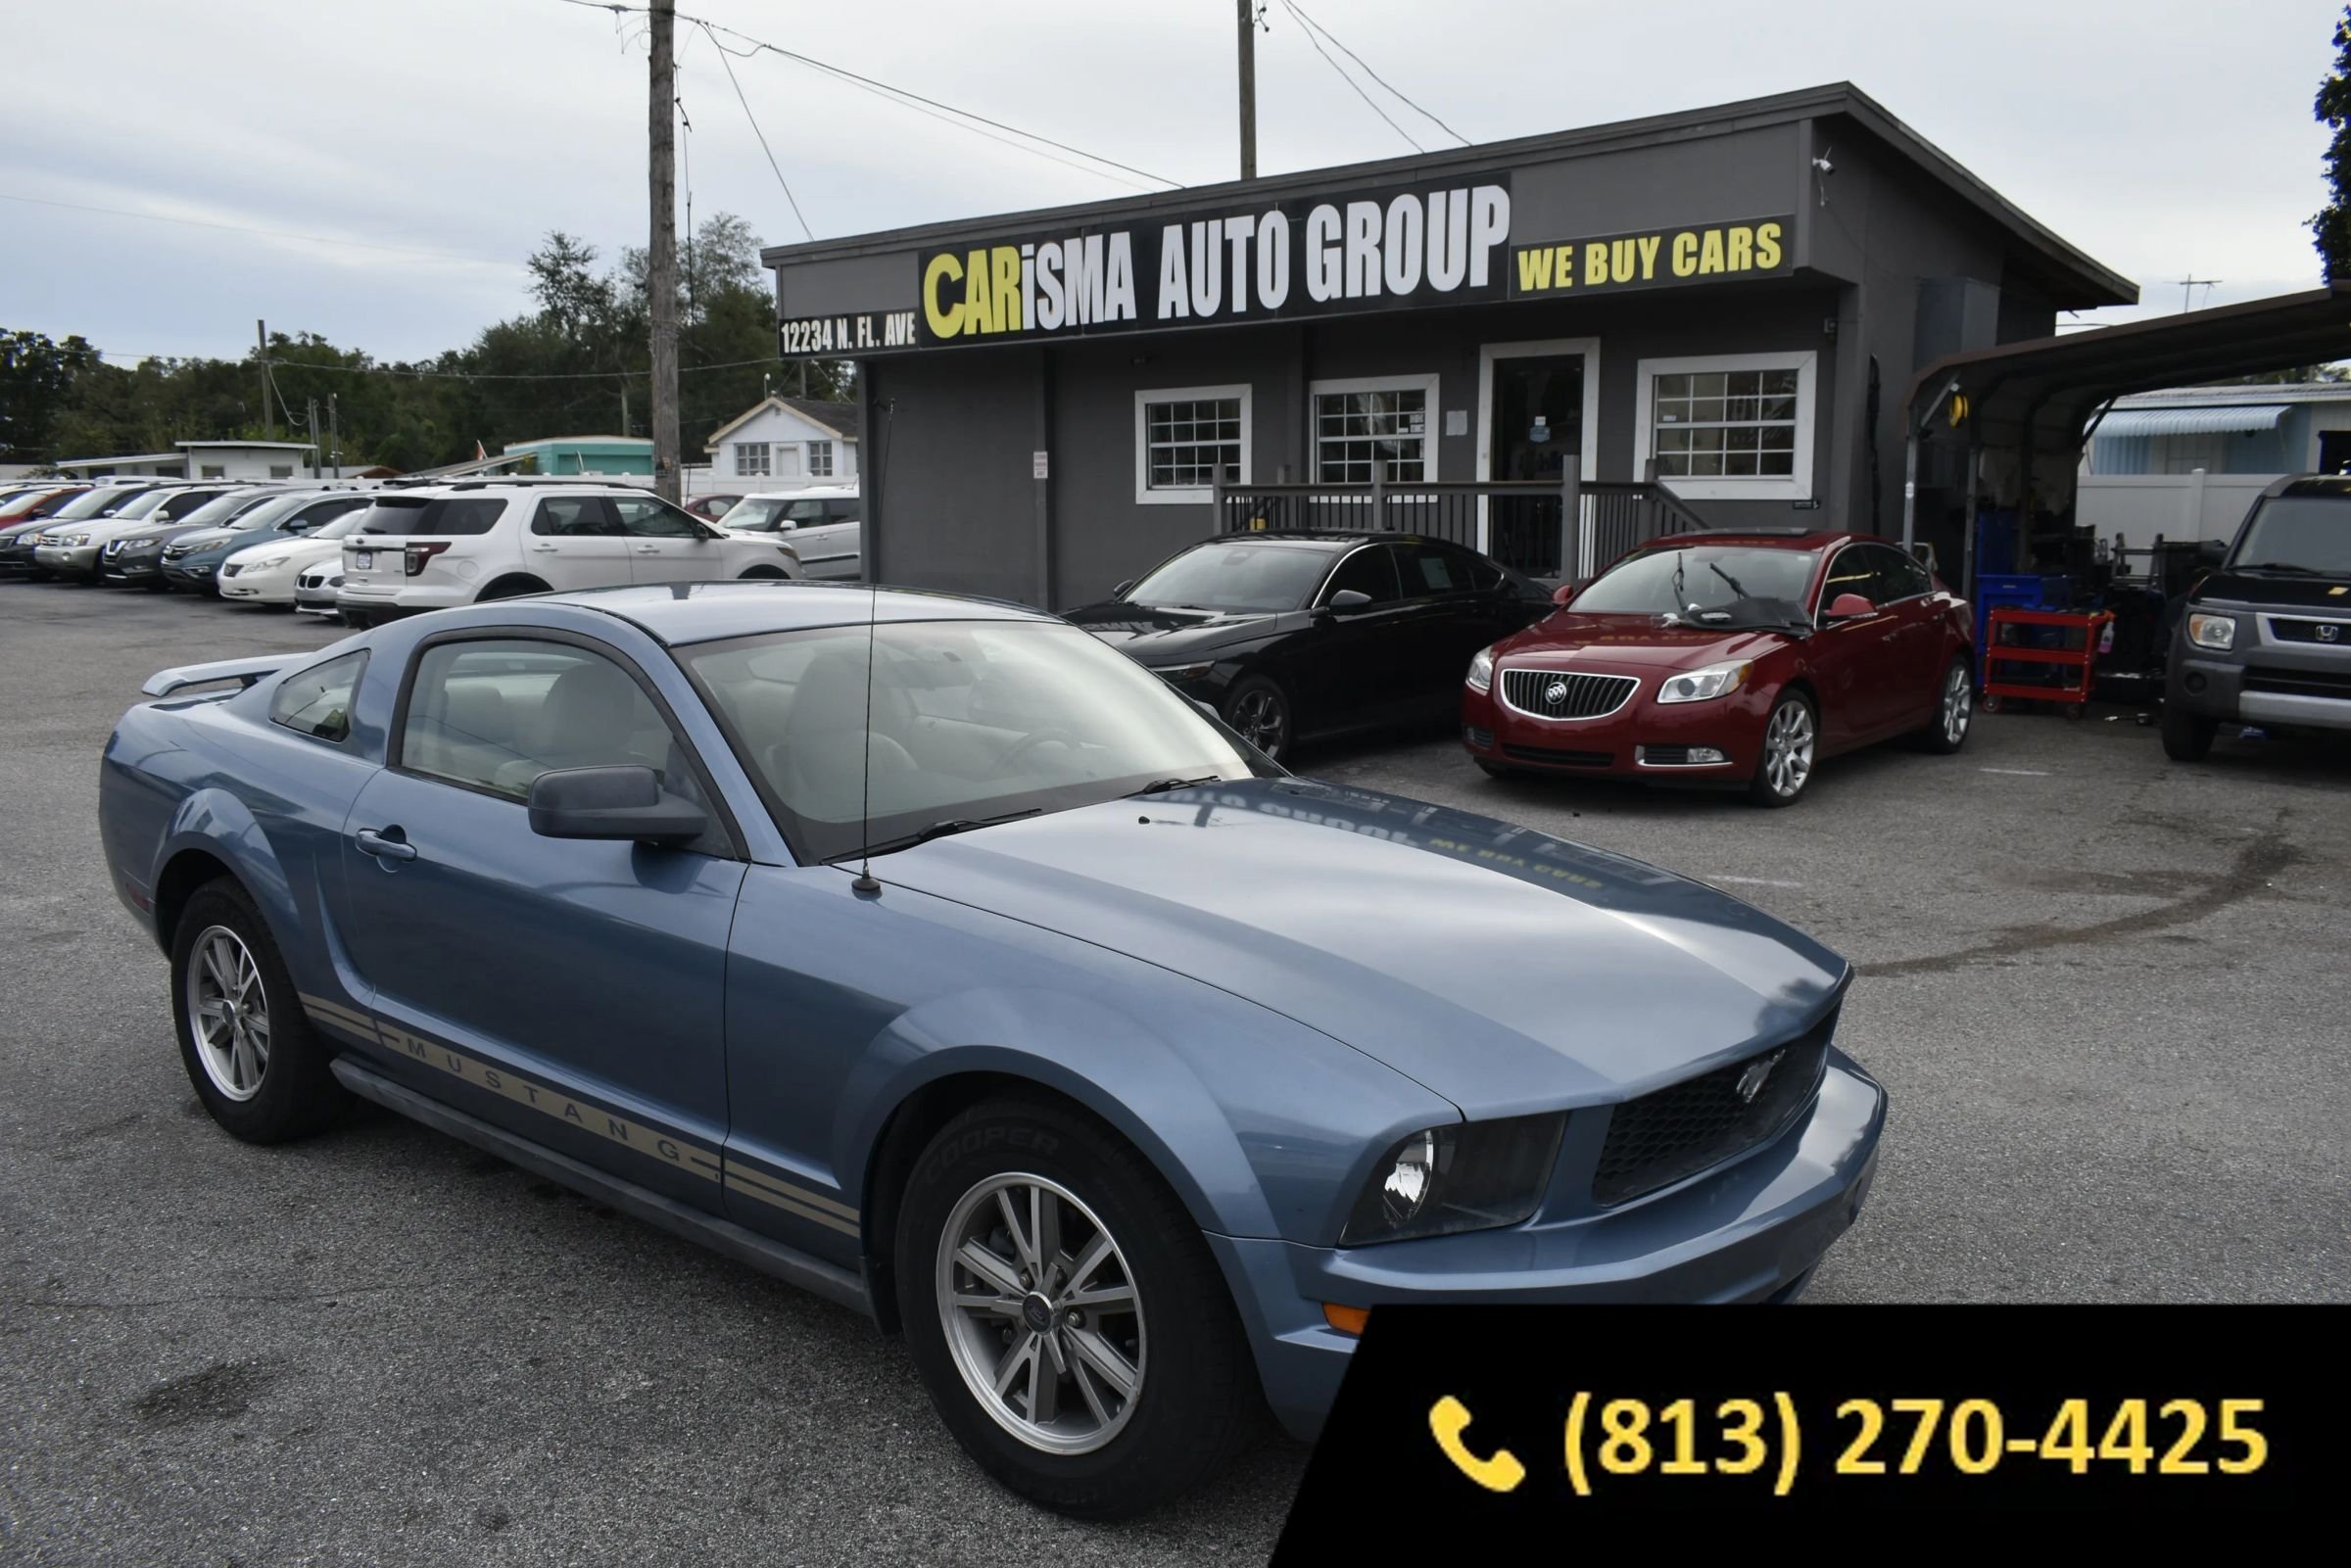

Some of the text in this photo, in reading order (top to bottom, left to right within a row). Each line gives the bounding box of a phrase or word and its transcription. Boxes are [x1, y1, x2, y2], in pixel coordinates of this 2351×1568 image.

[1157, 209, 1290, 320] AUTO
[1306, 184, 1511, 303] GROUP
[1517, 222, 1782, 292] WE BUY CARS
[781, 311, 916, 354] 12234 N. FL. AVE
[407, 1038, 680, 1162] MUSTANG
[924, 1124, 1059, 1185] COOPER
